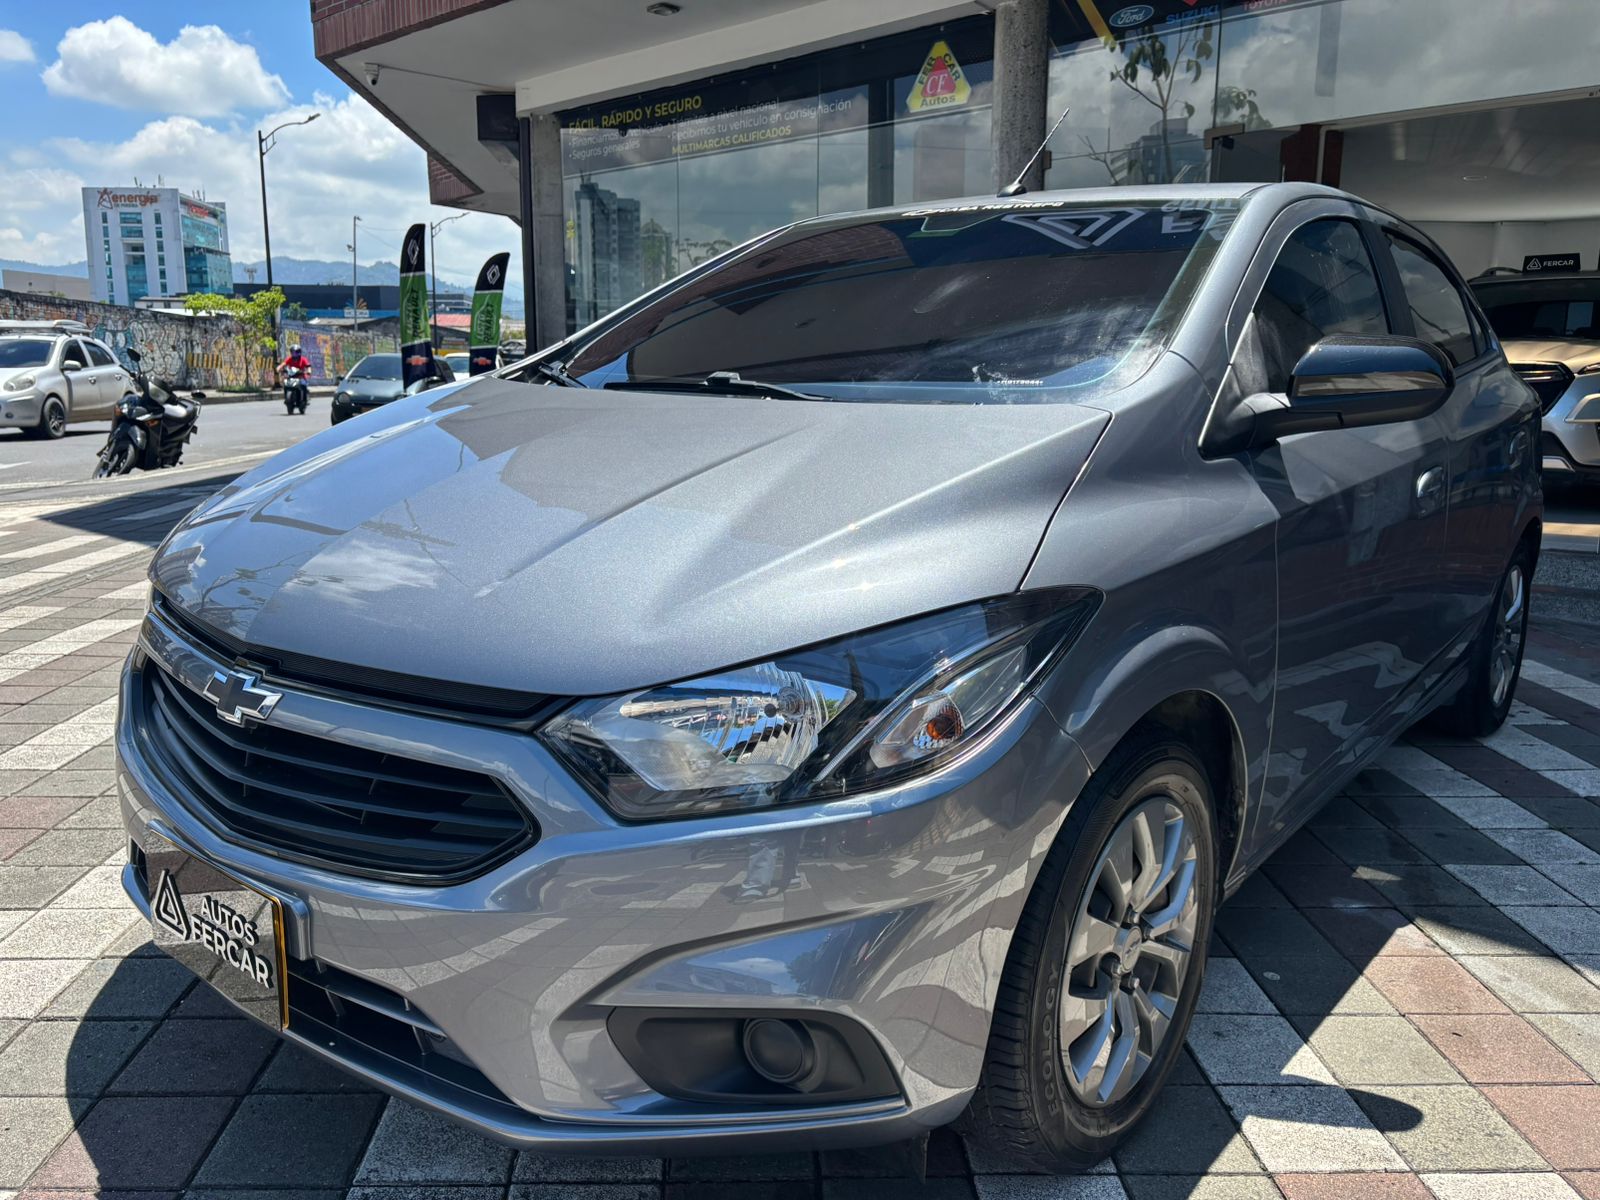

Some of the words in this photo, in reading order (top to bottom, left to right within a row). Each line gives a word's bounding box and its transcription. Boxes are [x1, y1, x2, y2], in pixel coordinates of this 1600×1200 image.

[1117, 8, 1145, 24] Ford
[1167, 5, 1219, 24] SUZUKI
[943, 53, 960, 81] CAR
[927, 73, 948, 94] CF
[602, 108, 642, 128] RÁPIDO
[645, 106, 652, 118] Y
[654, 96, 702, 117] SEGURO
[740, 97, 779, 115] nacional
[920, 95, 956, 108] Autos
[718, 123, 727, 133] tu
[770, 112, 782, 124] en
[784, 98, 852, 121] consignación
[671, 137, 731, 155] MULTIMARCAS
[732, 125, 791, 144] CALIFICADOS
[572, 147, 602, 160] Seguros
[1543, 259, 1574, 267] FERCAR
[201, 895, 259, 946] AUTOS
[191, 914, 274, 989] FERCAR
[1043, 960, 1058, 1115] ECOLOGY
